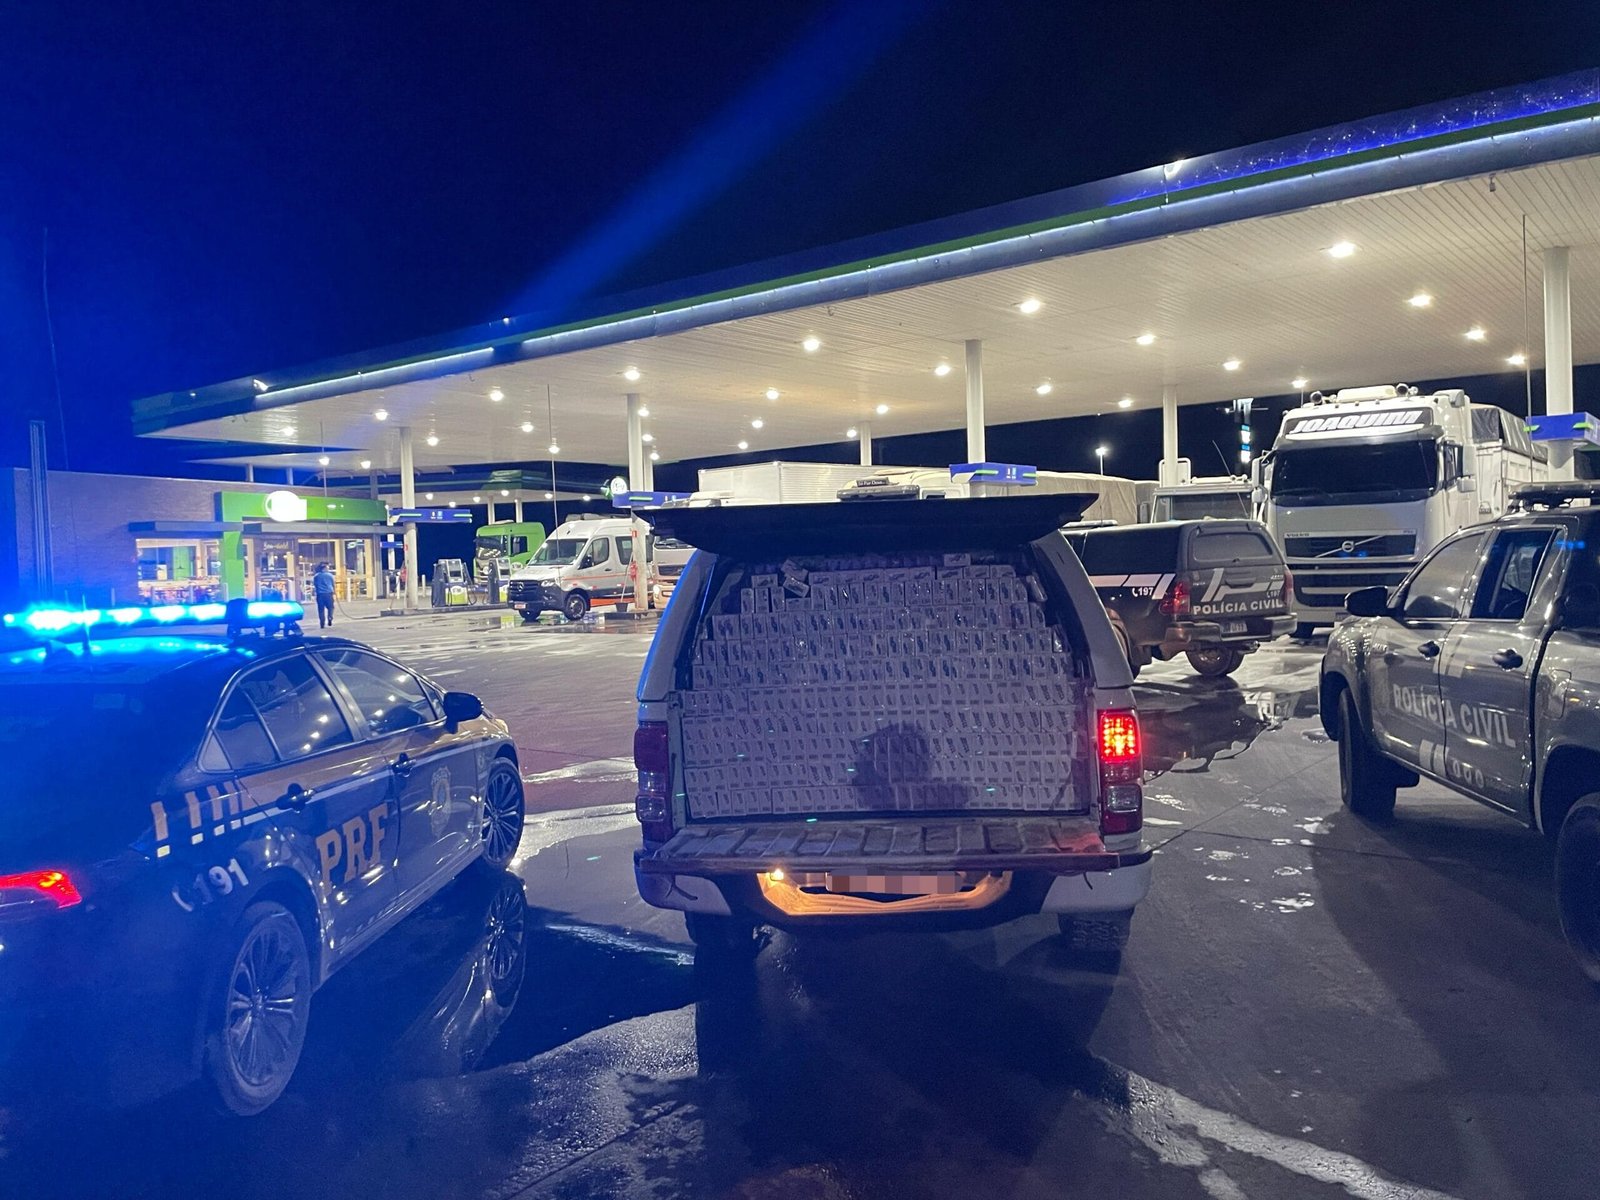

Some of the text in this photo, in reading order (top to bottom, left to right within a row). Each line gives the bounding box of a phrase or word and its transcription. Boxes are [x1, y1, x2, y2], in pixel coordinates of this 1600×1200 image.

[1138, 587, 1154, 596] 197
[1192, 598, 1284, 615] POLÍCIA CIVIL
[1393, 683, 1517, 748] POLÍCIA CIVIL
[315, 802, 388, 897] PRF
[192, 858, 249, 905] 191
